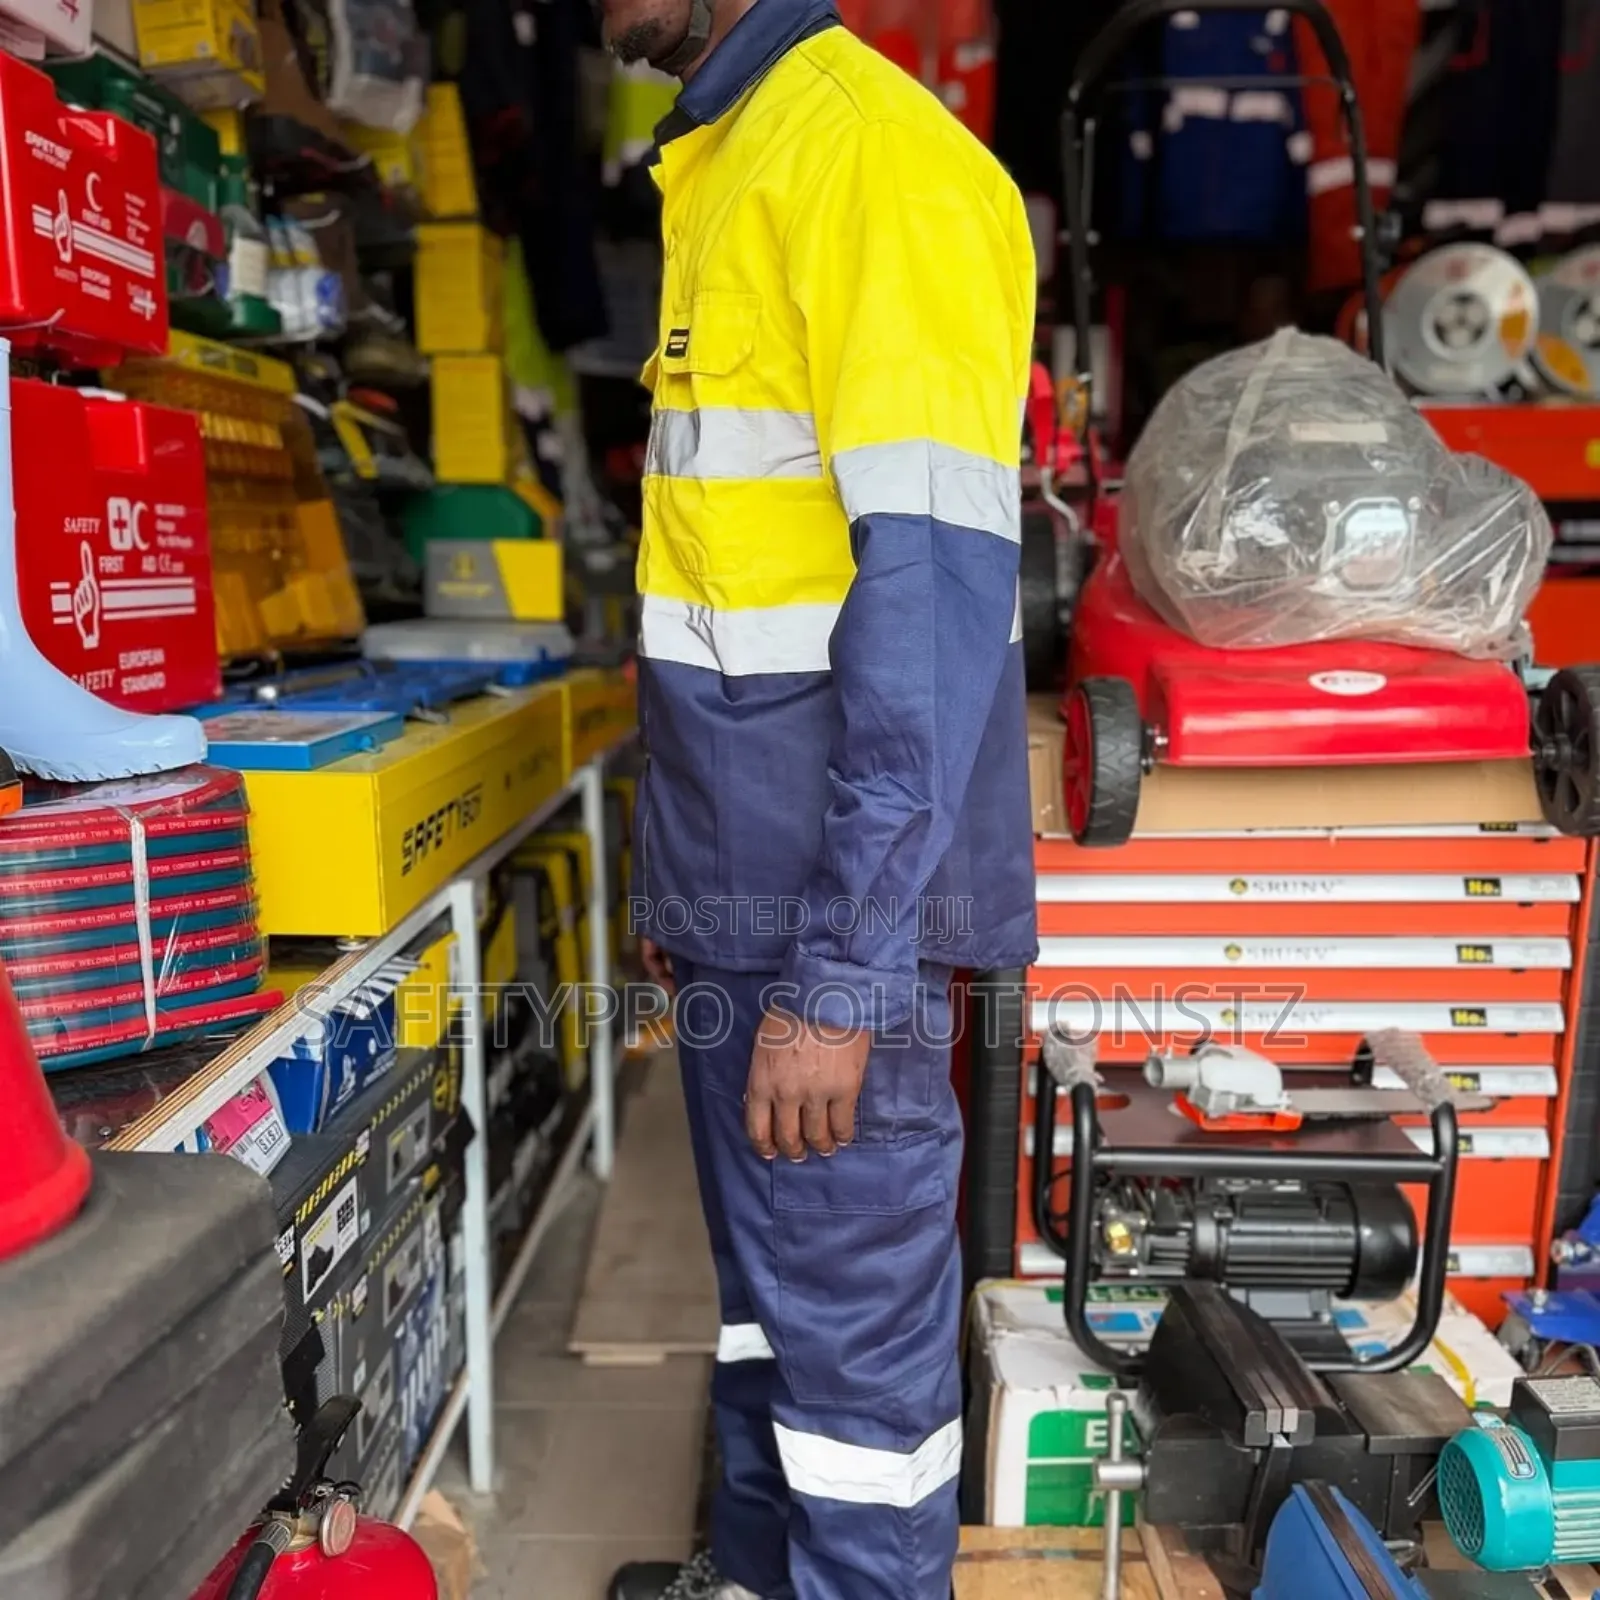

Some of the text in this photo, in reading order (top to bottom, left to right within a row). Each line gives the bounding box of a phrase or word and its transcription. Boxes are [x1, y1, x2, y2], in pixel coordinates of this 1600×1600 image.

[64, 517, 101, 534] SAFETY
[98, 555, 124, 574] FIRST
[1468, 879, 1500, 895] No.
[1460, 946, 1492, 962] No.
[1453, 1009, 1486, 1025] No.
